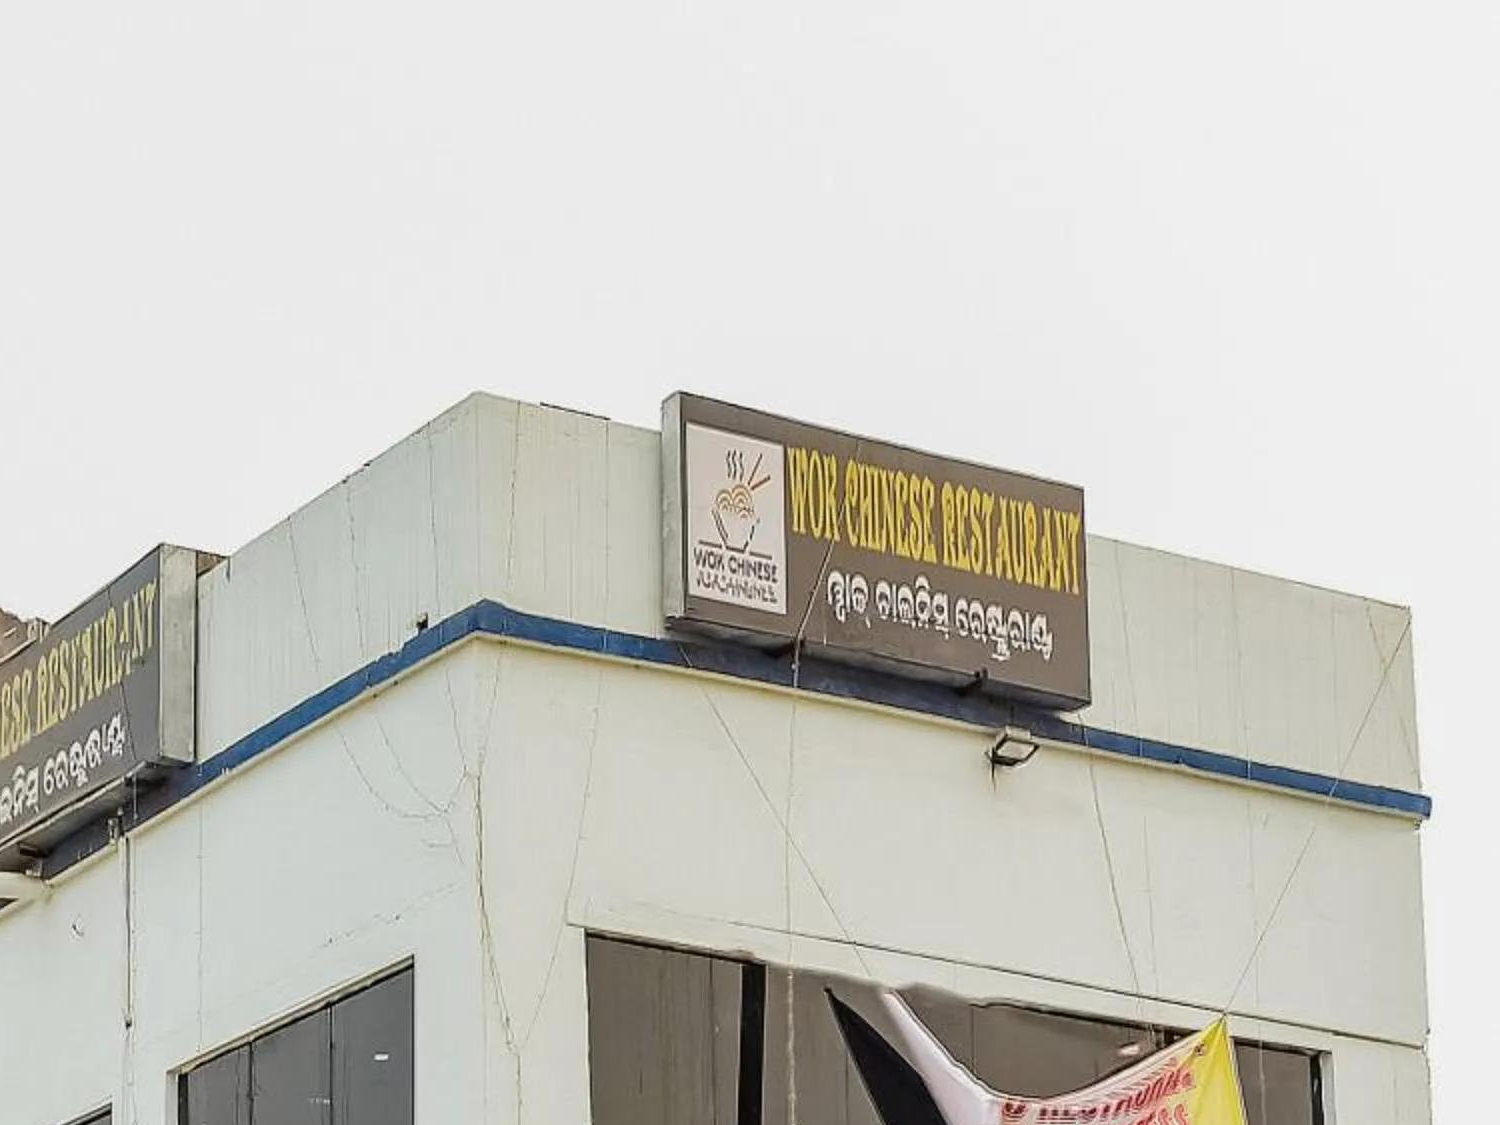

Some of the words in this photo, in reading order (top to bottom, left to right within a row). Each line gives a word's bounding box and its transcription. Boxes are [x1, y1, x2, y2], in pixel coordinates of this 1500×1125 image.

[728, 554, 778, 583] CHINESE
[787, 447, 840, 543] WOK
[843, 458, 937, 567] CHINESE
[941, 480, 1080, 595] RESTAURANT
[36, 578, 157, 738] RESTAURANT
